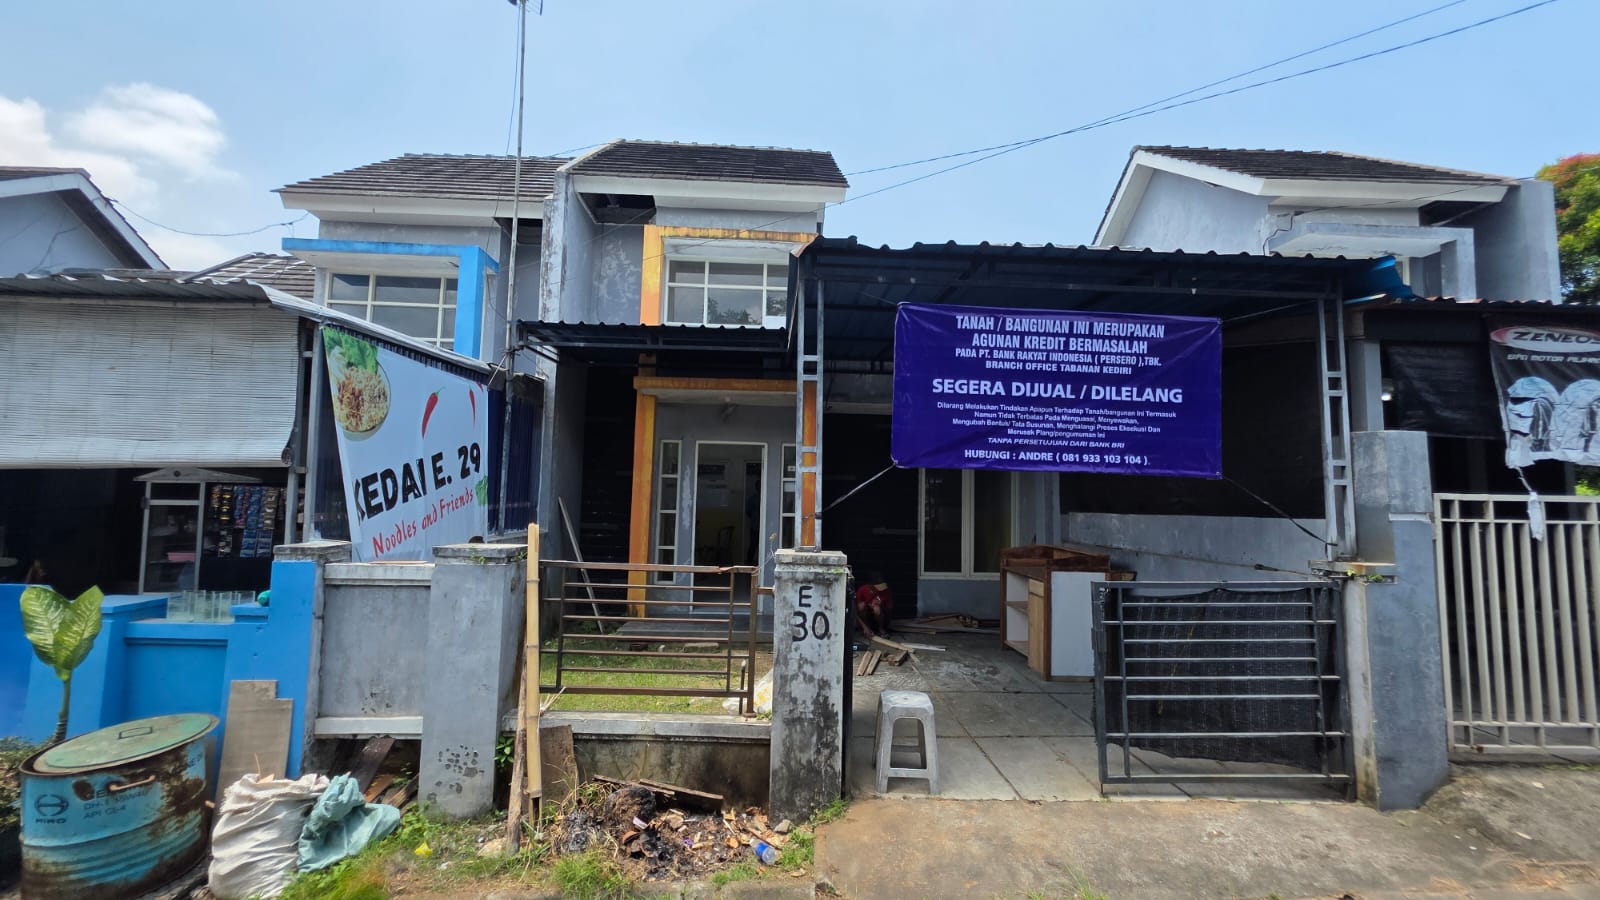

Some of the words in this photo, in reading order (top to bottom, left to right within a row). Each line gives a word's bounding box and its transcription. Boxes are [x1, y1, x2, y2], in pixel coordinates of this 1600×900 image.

[956, 315, 994, 330] TANAH
[997, 317, 1003, 332] /
[1005, 318, 1070, 334] BANGUNAN
[1073, 321, 1090, 335] INI
[1093, 322, 1165, 338] MERUPAKAN
[972, 333, 1020, 349] AGUNAN
[1024, 335, 1066, 351] KREDIT
[1069, 337, 1148, 354] BERMASALAH
[955, 348, 977, 358] PADA
[979, 349, 991, 359] PT.
[993, 350, 1016, 360] BANK
[1017, 351, 1047, 361] RAKYAT
[1049, 352, 1093, 363] INDONESIA
[1101, 355, 1137, 365] PERSERO
[986, 360, 1023, 370] BRANCH
[1025, 362, 1058, 372] OFFICE
[1060, 364, 1101, 374] TABANAN
[1103, 366, 1132, 375] KEDIRI
[932, 378, 1006, 396] SEGERA
[1012, 381, 1076, 399] DIJUAL
[1080, 385, 1087, 400] /
[1091, 385, 1183, 404] DILELANG
[937, 401, 964, 411] Dilarang
[965, 402, 999, 411] Melakukan
[1000, 404, 1029, 412] Tindakan
[1029, 405, 1053, 414] Apapun
[1054, 406, 1084, 415] Terhadap
[1146, 410, 1177, 419] Termasuk
[998, 411, 1015, 420] Tidak
[1017, 412, 1043, 421] Terbatas
[1044, 413, 1061, 421] Pada
[952, 418, 986, 427] Mengubah
[1012, 420, 1025, 428] Tata
[1057, 422, 1096, 431] Menghalangi
[1097, 423, 1118, 431] Proses
[1119, 424, 1147, 433] Eksekusi
[988, 437, 1013, 445] TANPA
[1014, 438, 1069, 447] PERSETUJUAN
[964, 449, 1010, 460] HUBUNGI
[1018, 451, 1054, 461] ANDRE
[1062, 453, 1080, 462] 081
[1082, 454, 1101, 463] 933
[1103, 454, 1121, 463] 103
[1123, 455, 1142, 464] 104
[352, 457, 428, 526] KEDAI
[431, 451, 453, 490] E.
[457, 442, 481, 480] 29
[372, 519, 417, 558] Noodles
[422, 503, 438, 530] and
[440, 487, 474, 520] Friends
[799, 586, 813, 608] E
[791, 611, 830, 641] 30
